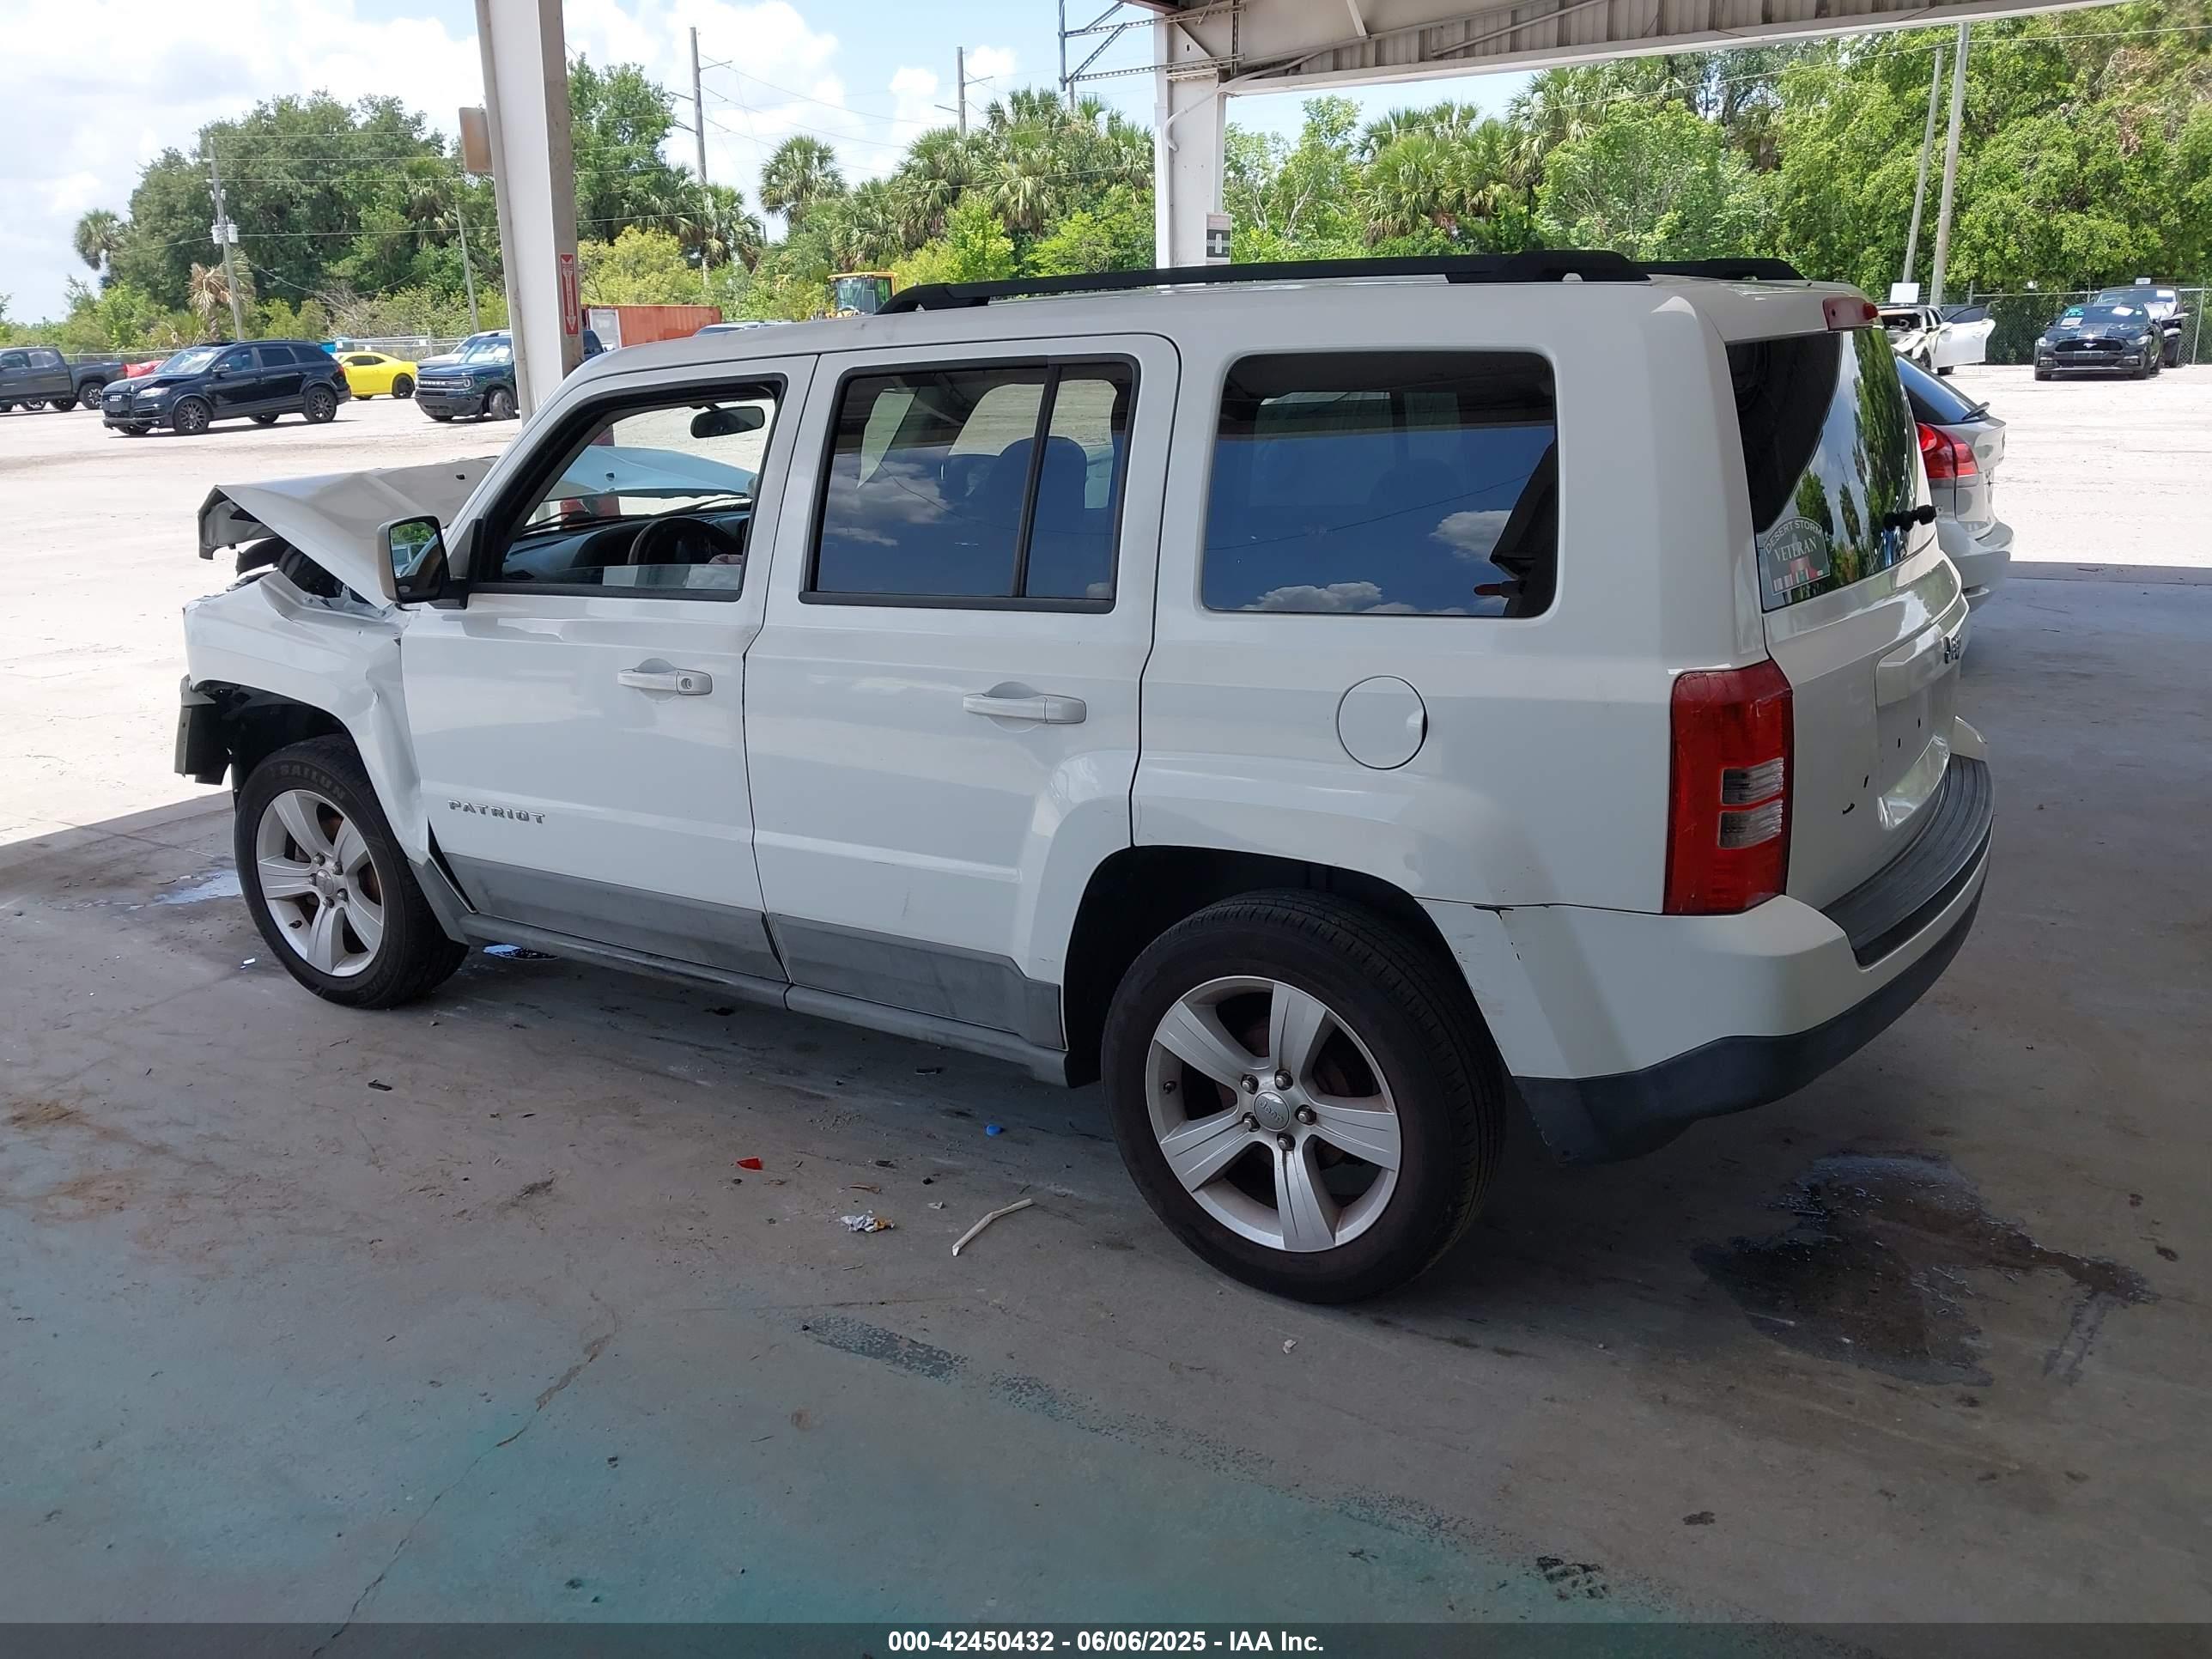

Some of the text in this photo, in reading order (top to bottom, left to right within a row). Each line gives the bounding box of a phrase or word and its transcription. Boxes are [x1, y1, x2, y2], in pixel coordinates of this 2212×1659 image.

[1765, 519, 1823, 555] DESERT STORM
[1774, 537, 1818, 562] VETERAN
[447, 799, 545, 824] PATRIOT
